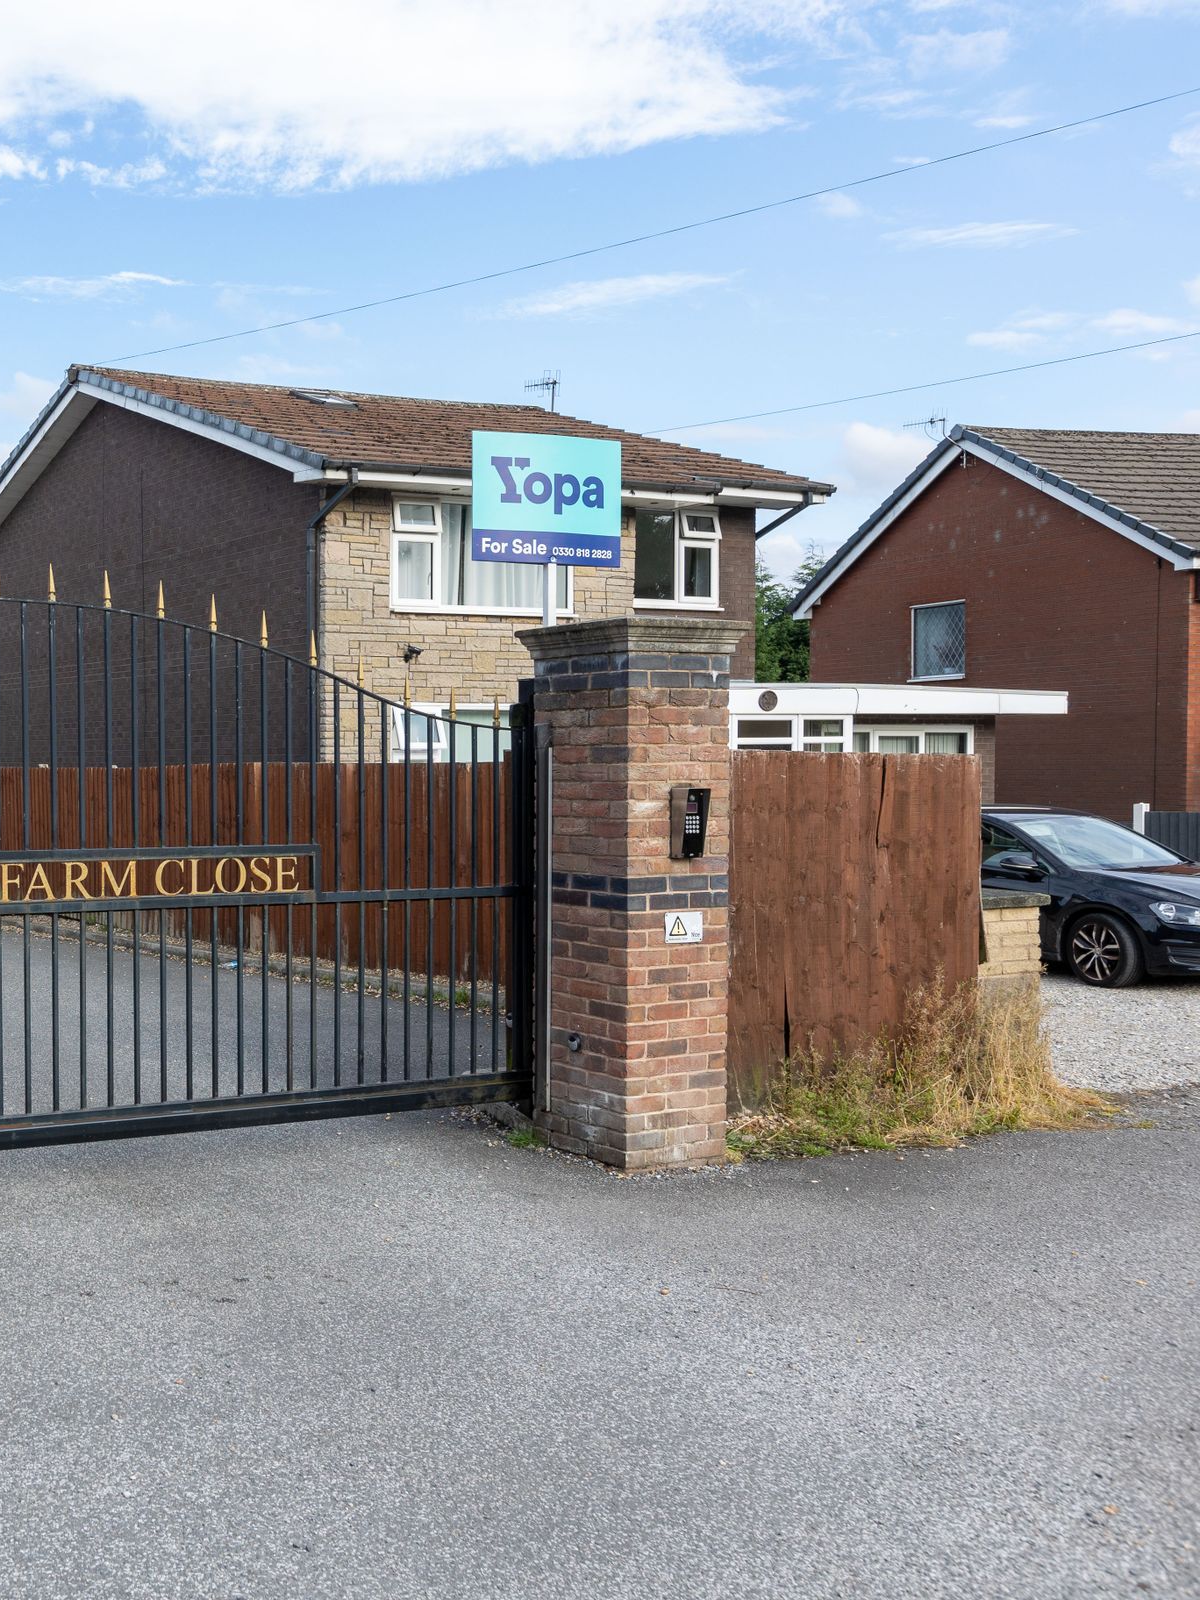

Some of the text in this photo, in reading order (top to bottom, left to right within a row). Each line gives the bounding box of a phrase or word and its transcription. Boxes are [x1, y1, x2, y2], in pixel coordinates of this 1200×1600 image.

[491, 456, 604, 515] Yopa
[481, 537, 612, 559] For Sale 0330 818 2828
[0, 859, 138, 902] FARM
[155, 856, 300, 897] CLOSE
